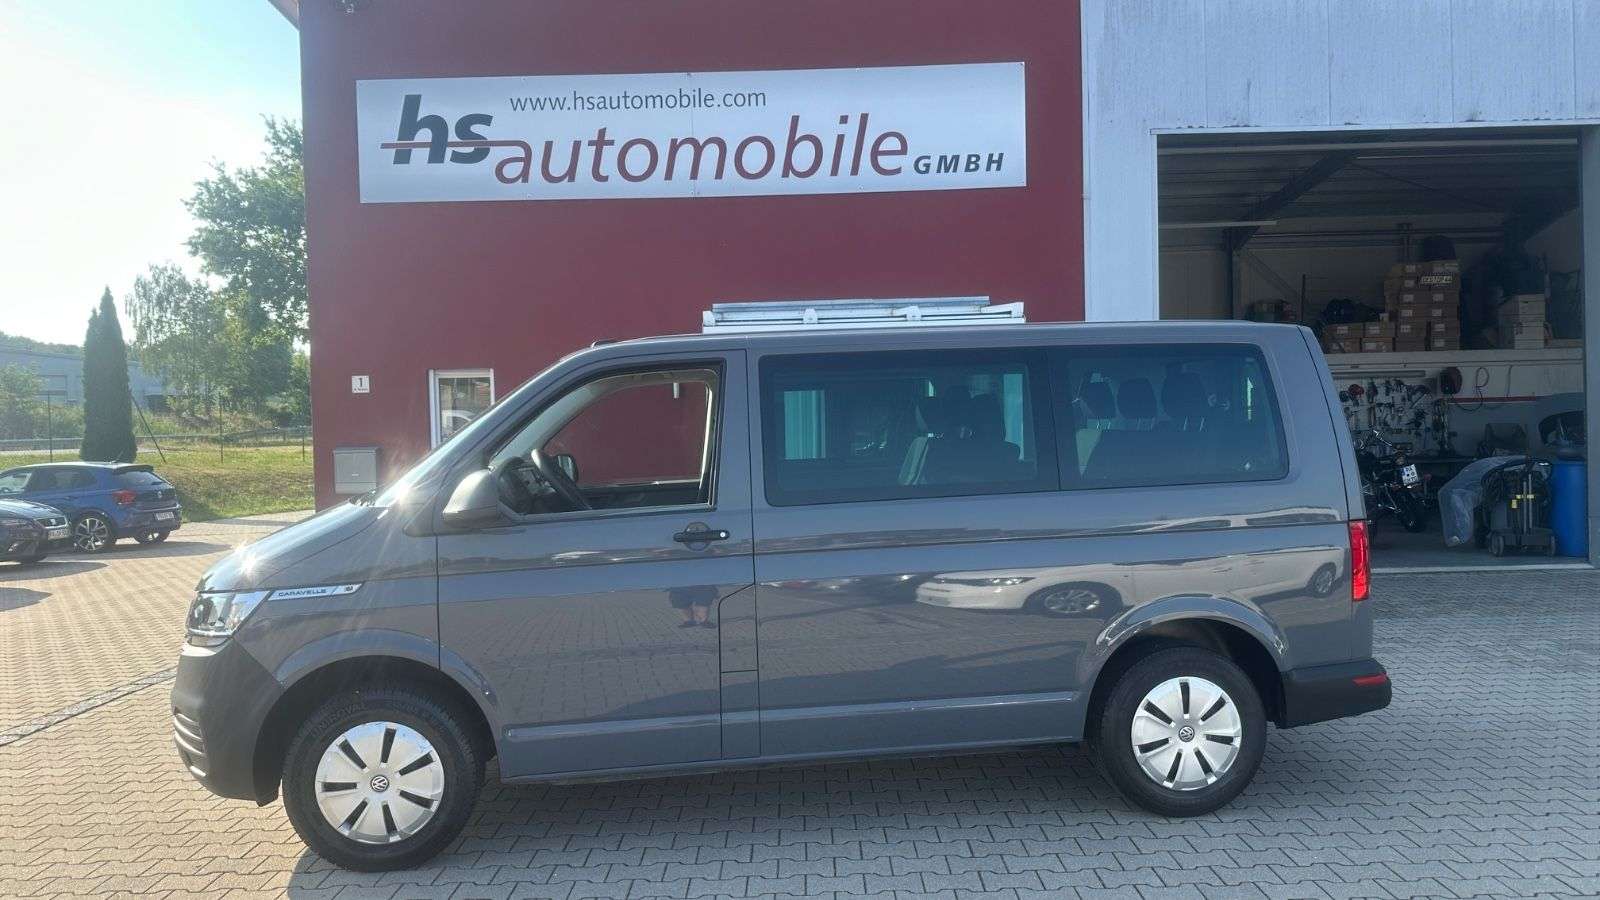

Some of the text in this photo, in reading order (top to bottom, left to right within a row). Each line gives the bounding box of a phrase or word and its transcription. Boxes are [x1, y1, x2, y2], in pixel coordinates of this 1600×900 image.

[510, 88, 767, 113] www.hsautomobile.com
[392, 94, 1005, 184] hs automobile GMBH
[358, 377, 363, 387] 1
[278, 588, 327, 597] CARAVELLE
